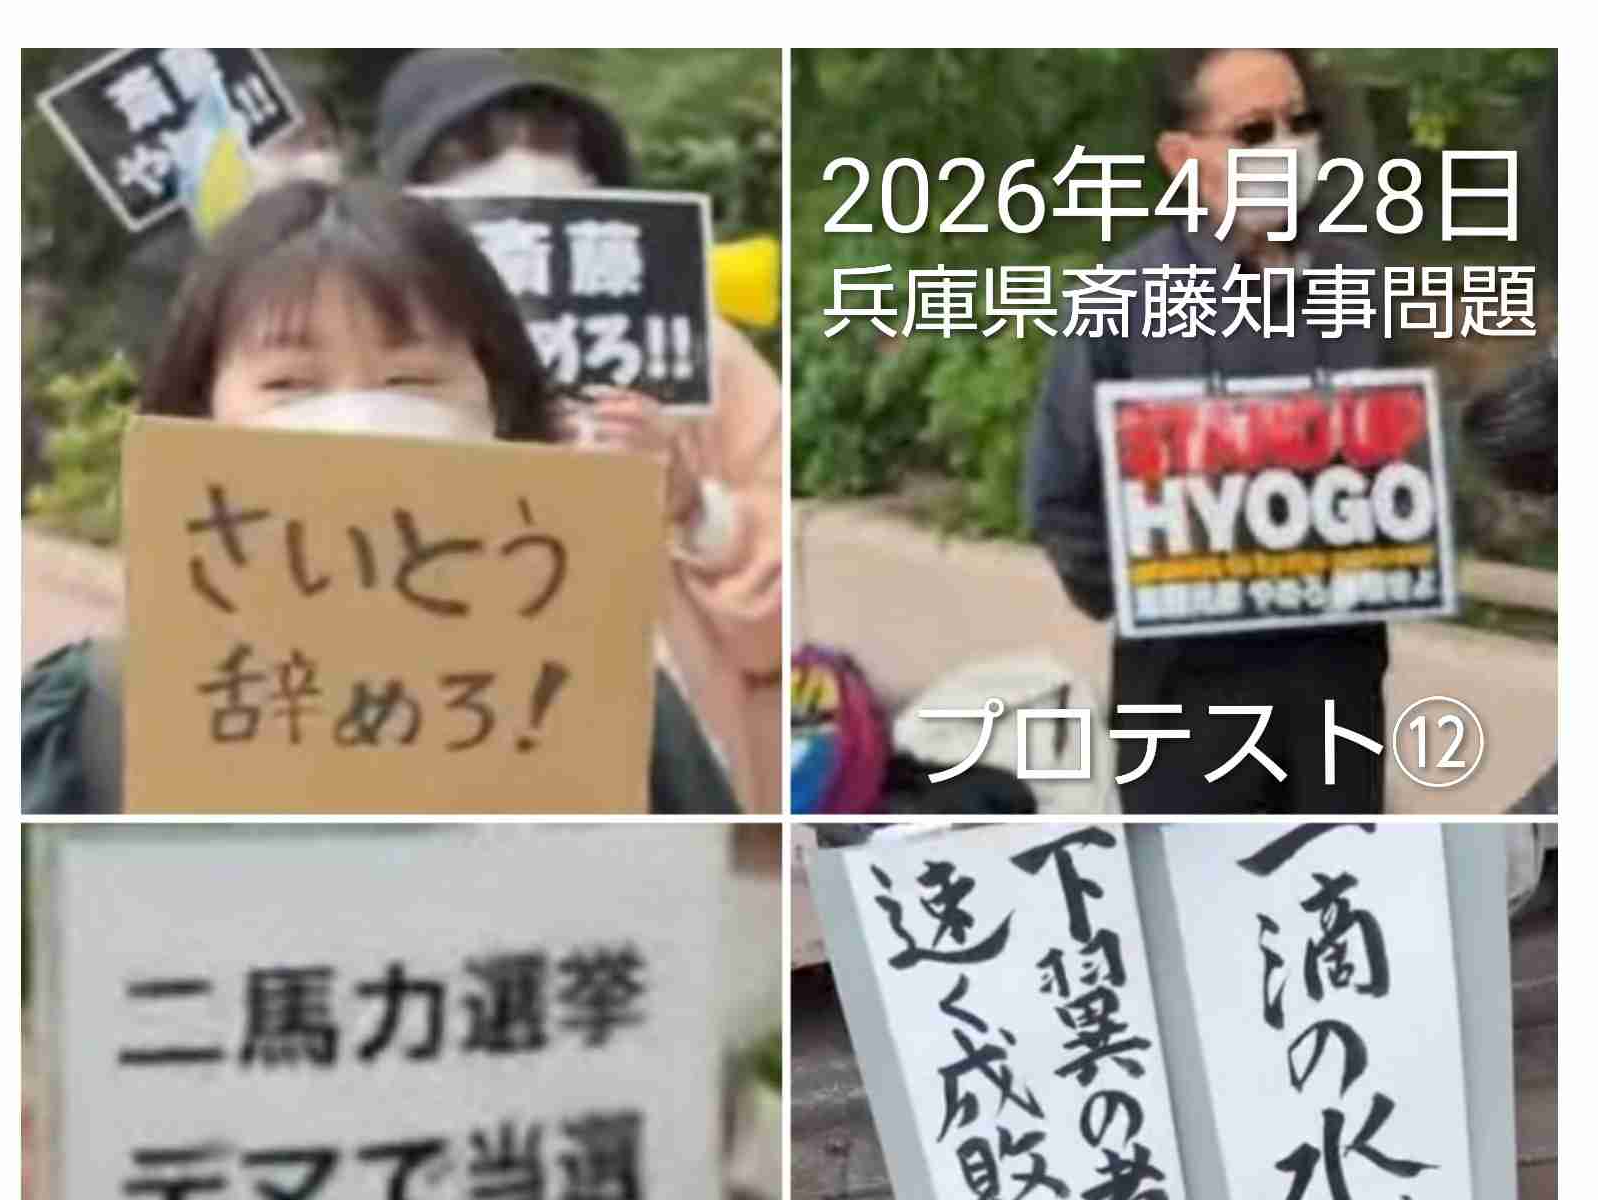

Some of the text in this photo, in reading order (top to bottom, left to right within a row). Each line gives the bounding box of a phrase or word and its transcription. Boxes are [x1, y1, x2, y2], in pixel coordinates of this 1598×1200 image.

[186, 484, 568, 617] さいとう
[1123, 461, 1437, 557] HYOGO
[197, 642, 571, 754] 辞めろ!
[119, 942, 649, 1068] 二馬力選挙
